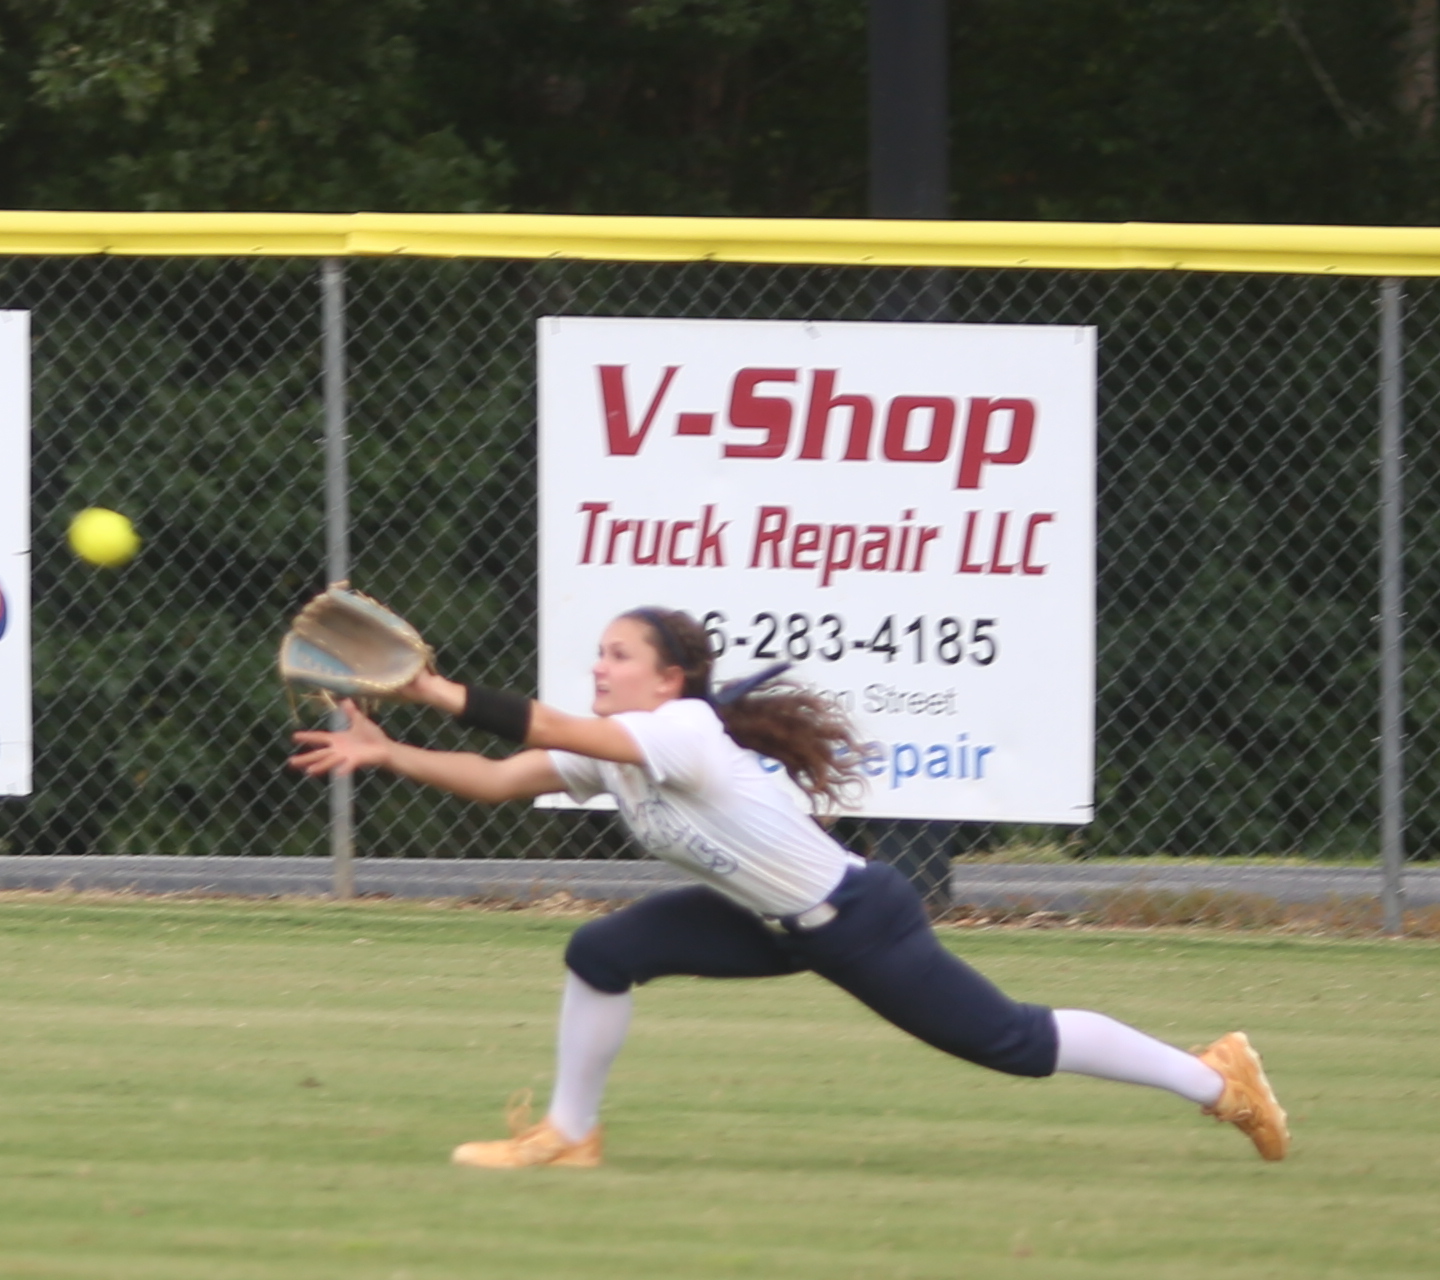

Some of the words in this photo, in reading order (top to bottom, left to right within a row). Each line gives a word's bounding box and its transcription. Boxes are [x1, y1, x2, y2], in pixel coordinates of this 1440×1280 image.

[595, 363, 1039, 490] V-Shop
[577, 500, 733, 567] Truck
[746, 504, 941, 588] Repair
[956, 509, 1056, 576] LLC
[703, 610, 999, 667] 6-283-4185
[863, 683, 959, 717] Street
[834, 733, 996, 790] epair
